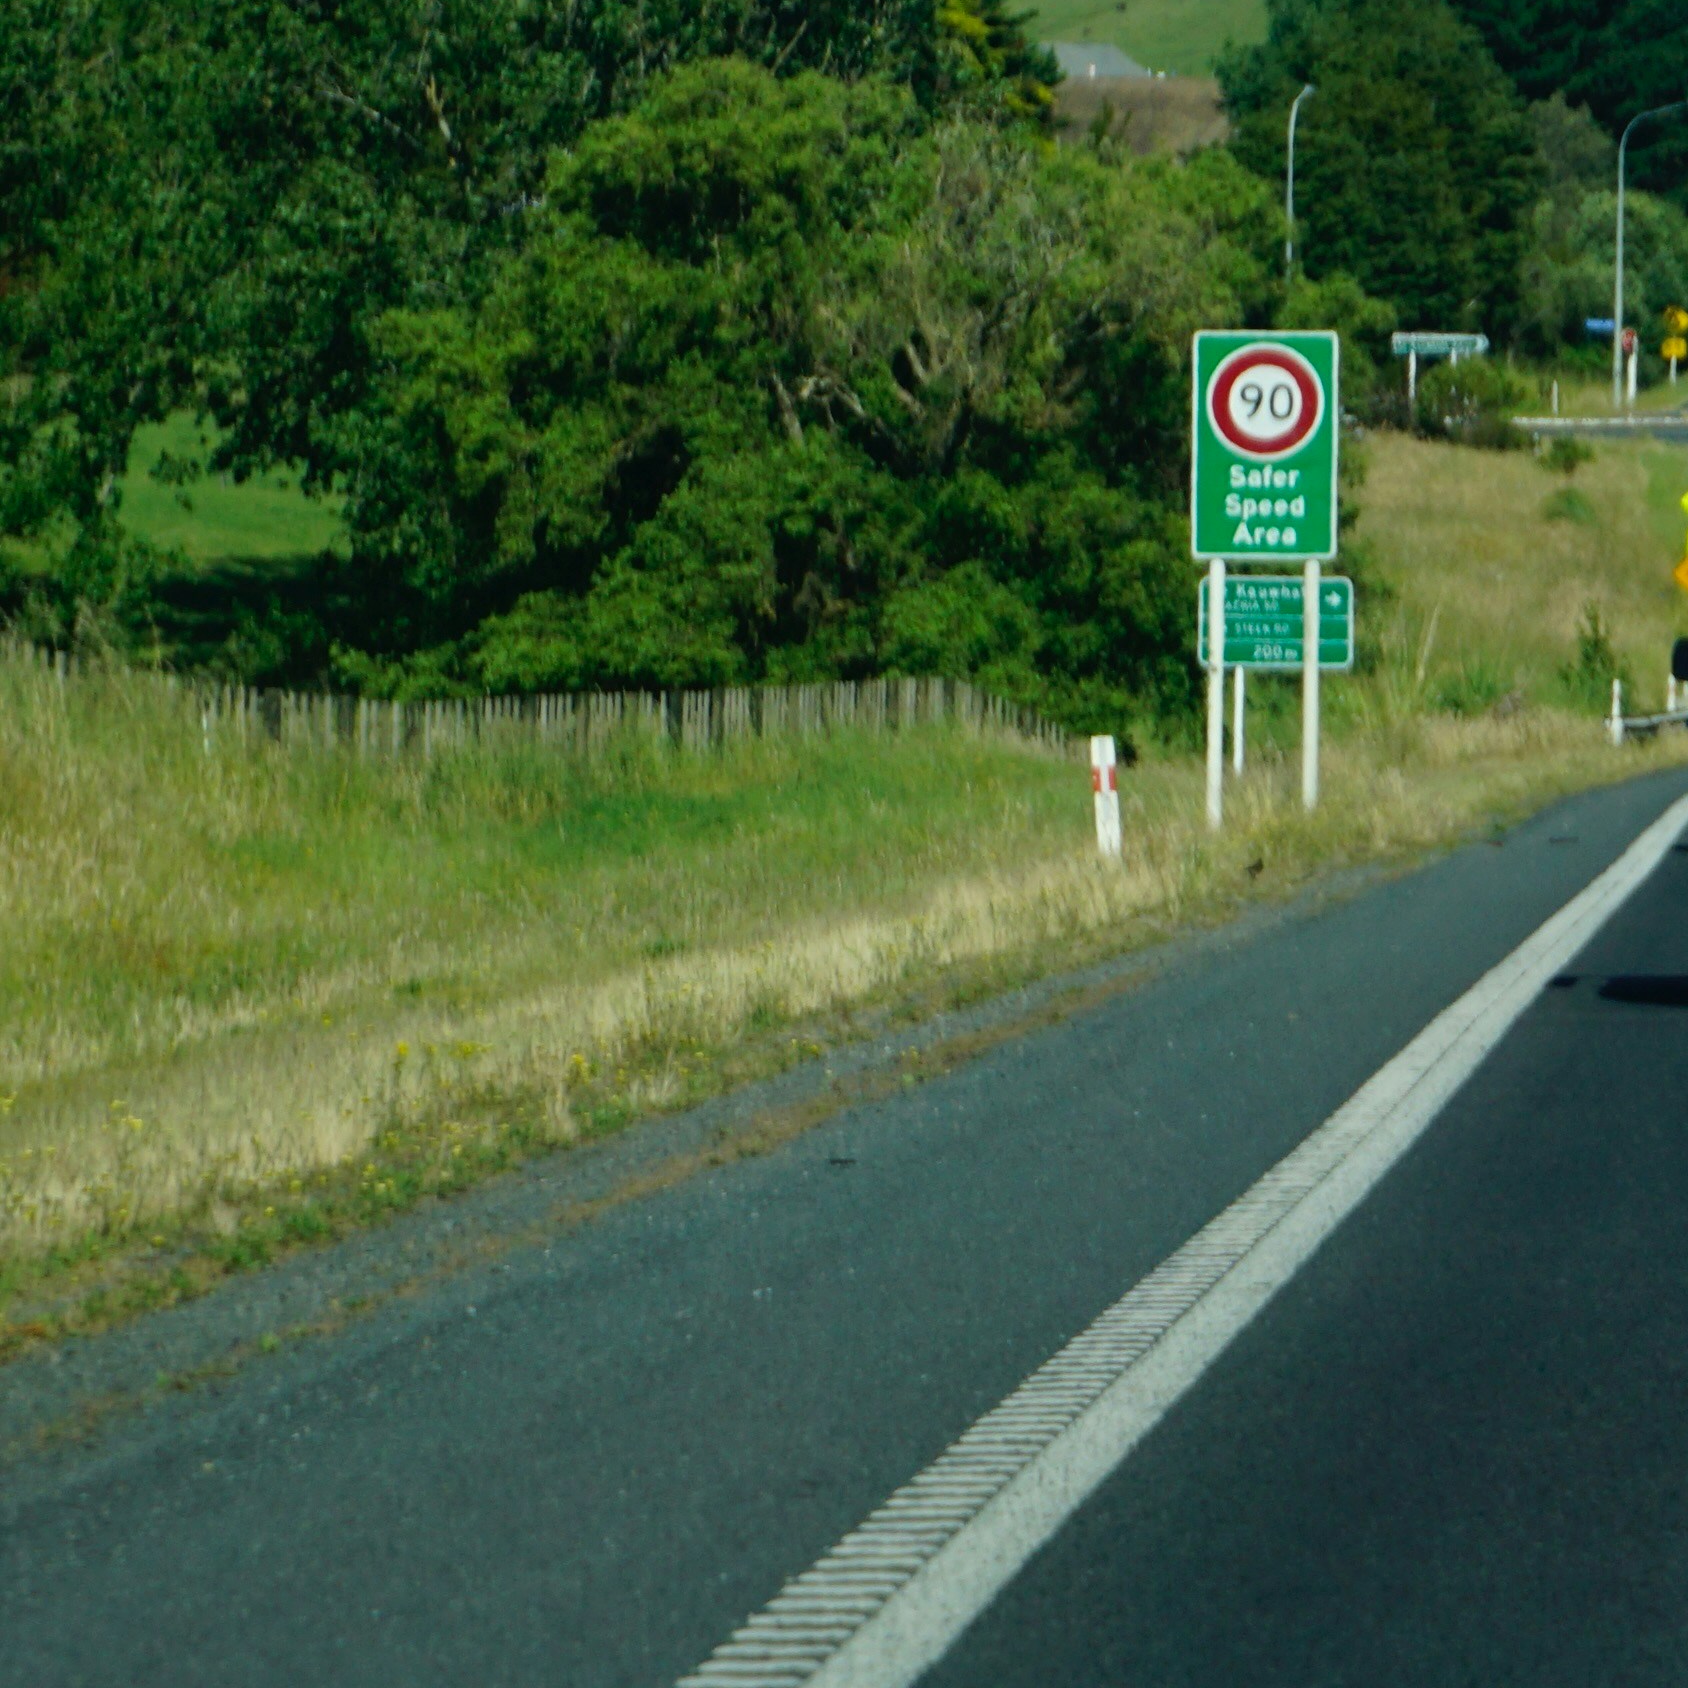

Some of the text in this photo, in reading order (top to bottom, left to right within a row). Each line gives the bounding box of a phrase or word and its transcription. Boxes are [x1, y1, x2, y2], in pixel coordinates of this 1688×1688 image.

[1240, 383, 1294, 419] 90
[1230, 464, 1300, 488] Safer
[1225, 493, 1305, 521] Speed
[1233, 521, 1297, 546] Area
